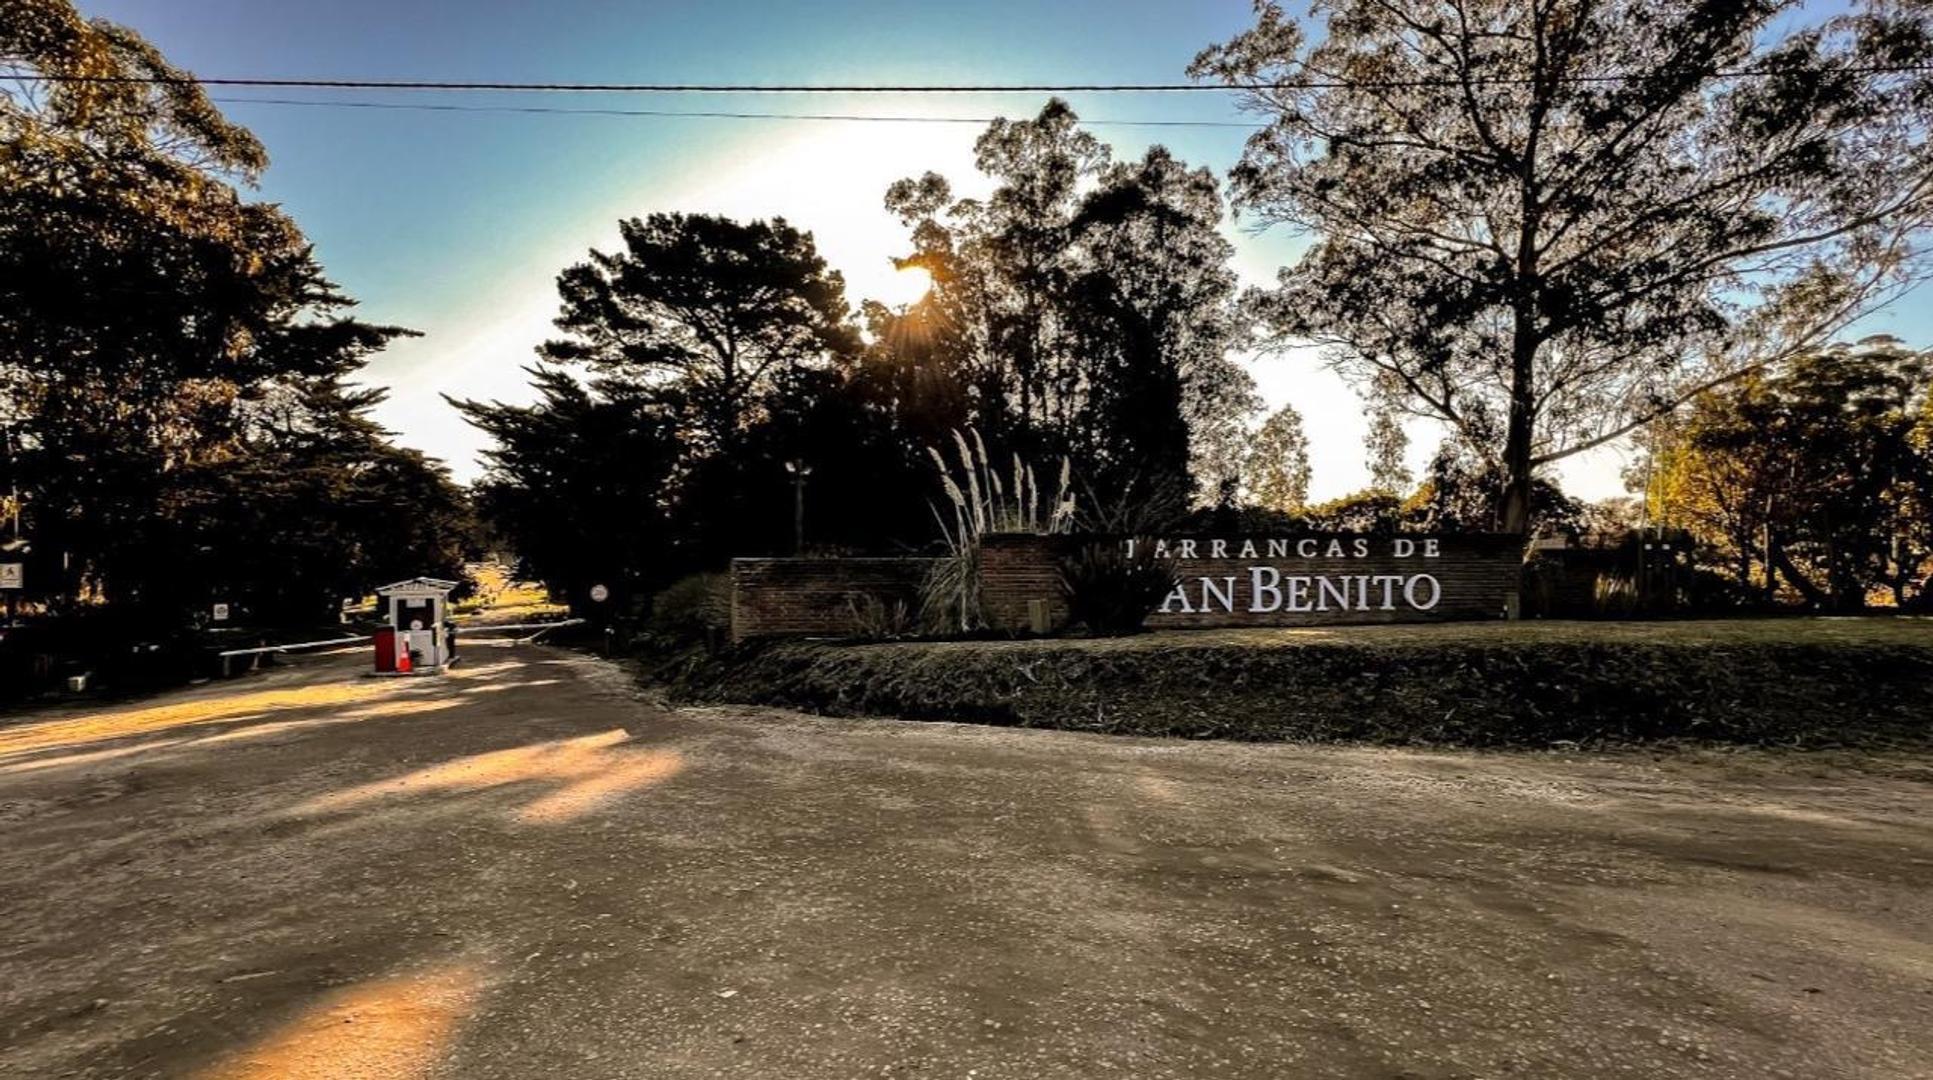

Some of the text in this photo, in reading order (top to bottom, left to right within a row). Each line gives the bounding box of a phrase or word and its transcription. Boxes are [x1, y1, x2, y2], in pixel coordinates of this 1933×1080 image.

[1393, 538, 1440, 558] DE
[1157, 566, 1441, 613] AN BENITO
